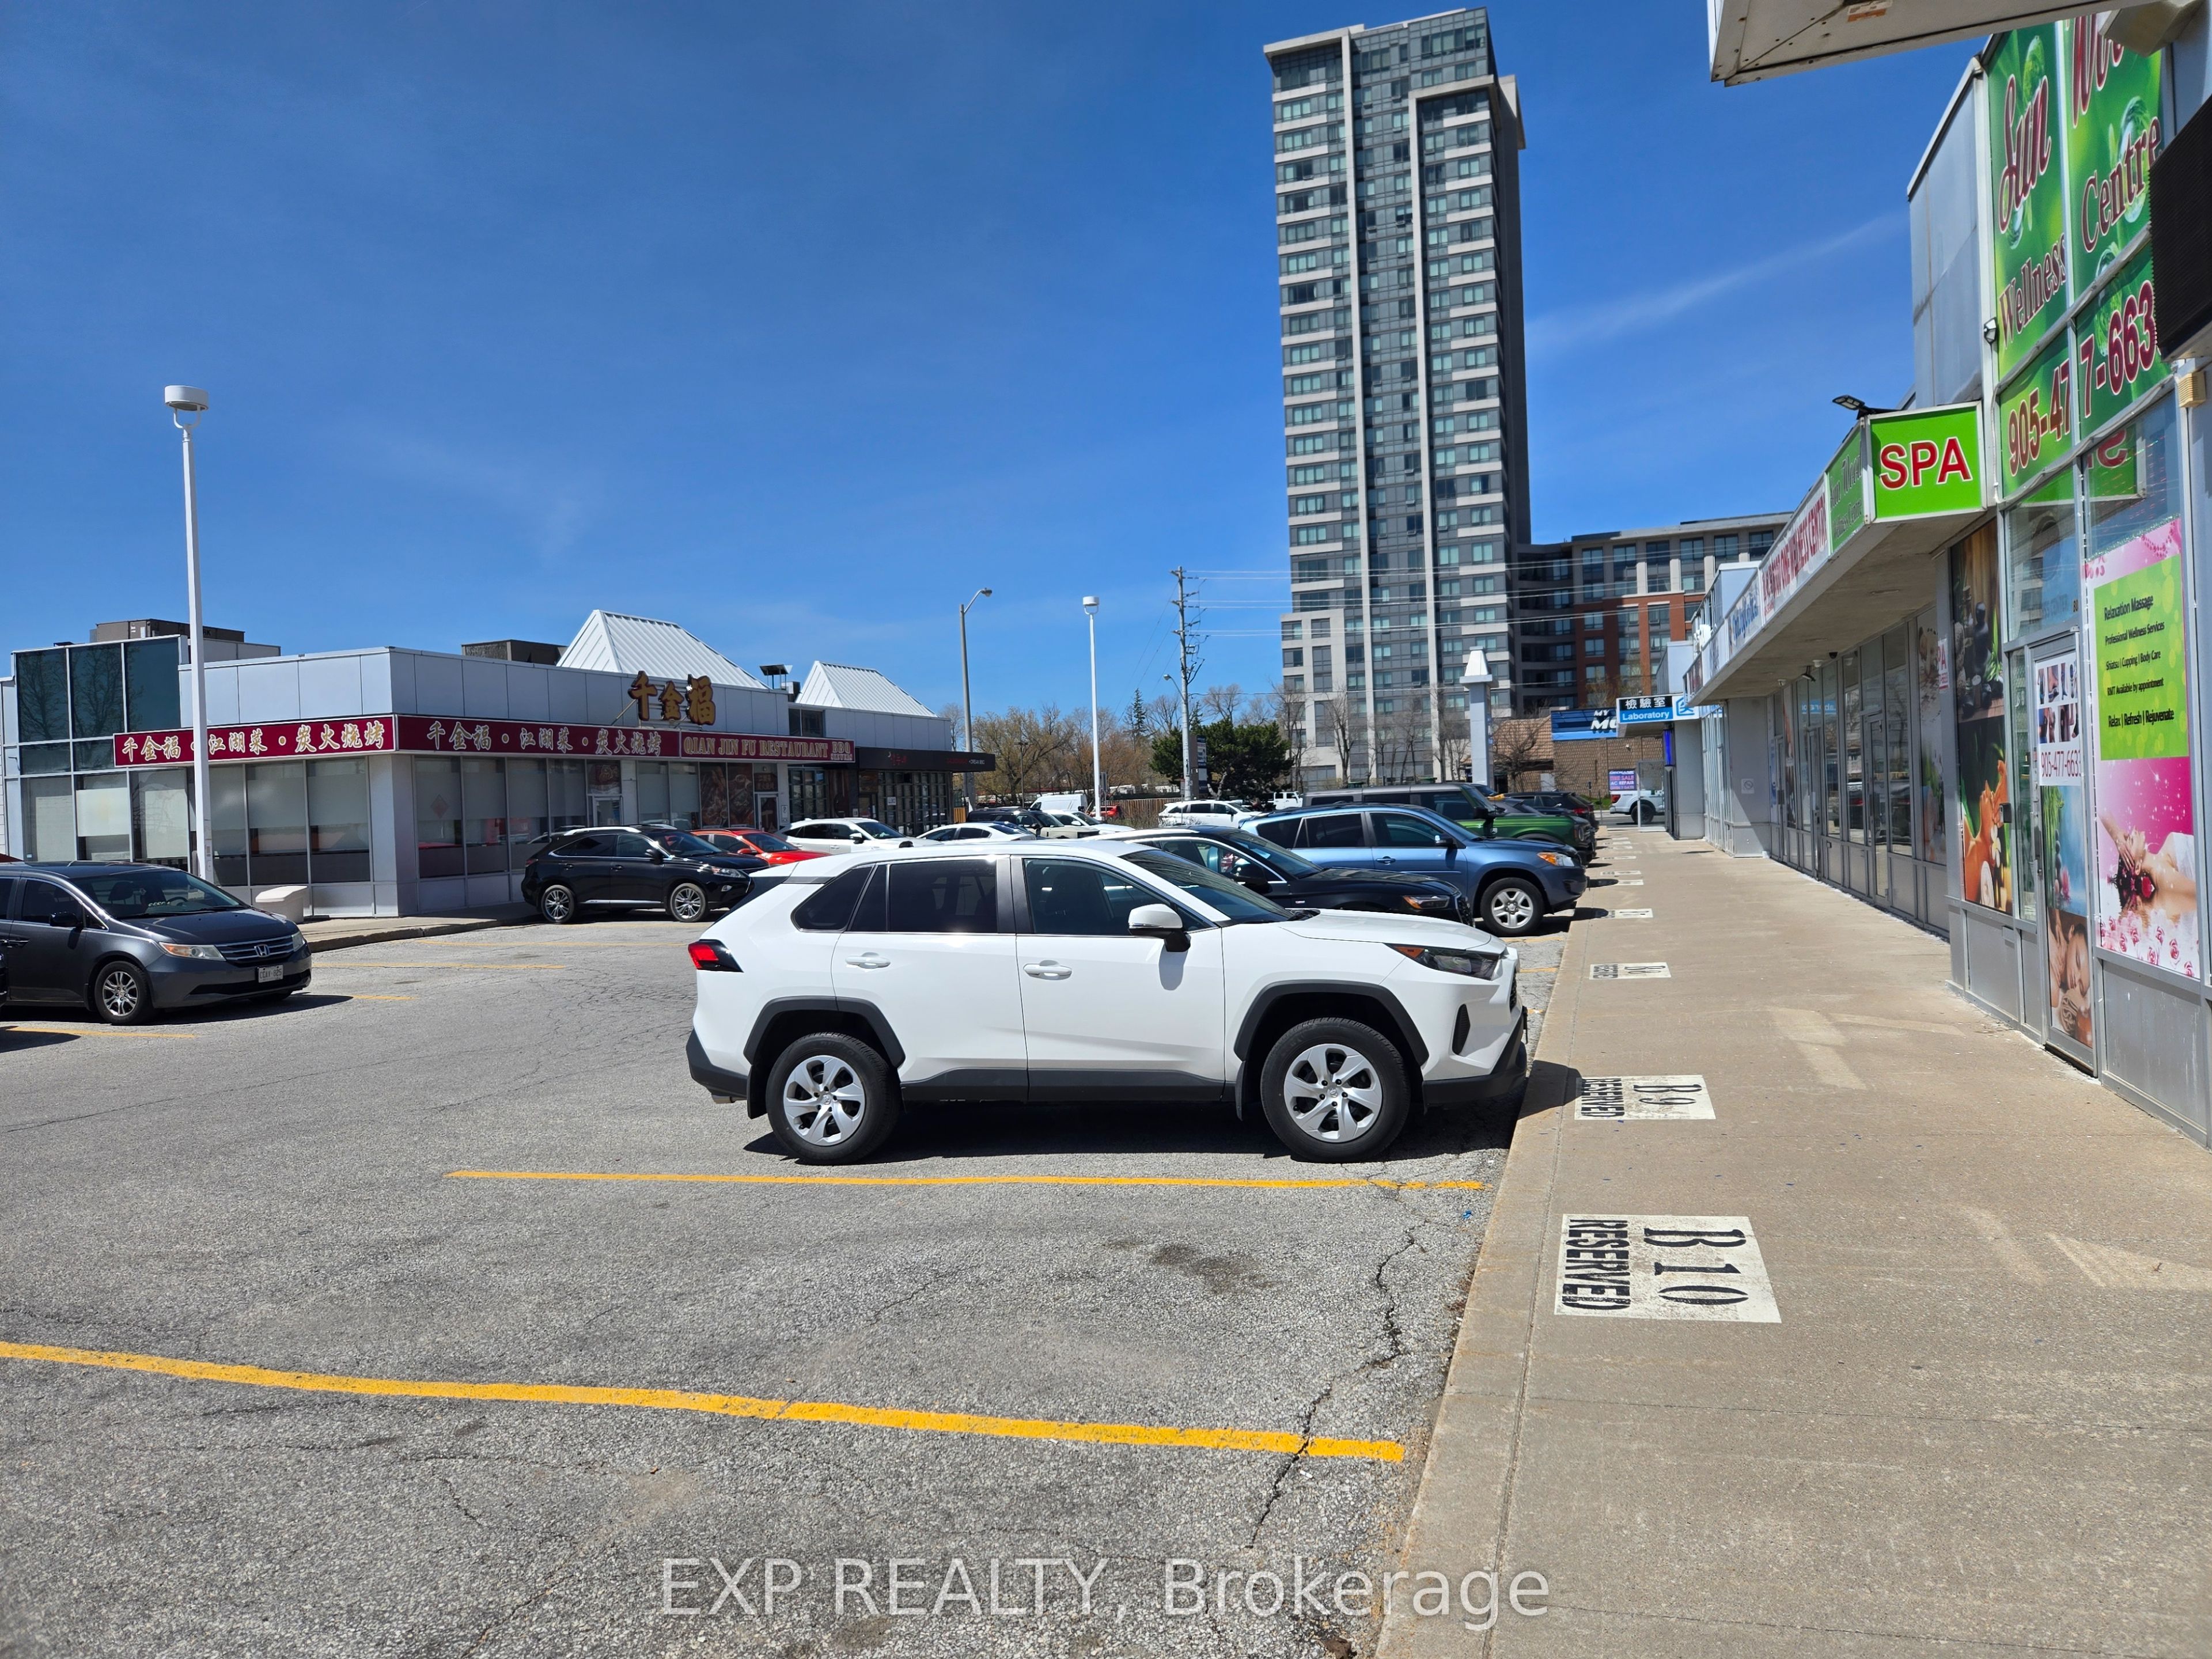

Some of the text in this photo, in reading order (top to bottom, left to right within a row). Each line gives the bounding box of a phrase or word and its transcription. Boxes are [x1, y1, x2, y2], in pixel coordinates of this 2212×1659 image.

[1998, 74, 2052, 234] Sun
[1998, 232, 2066, 349] Wellness
[2008, 280, 2157, 477] 905-477-663
[1880, 436, 1973, 490] SPA
[2104, 595, 2154, 621] Relaxation Massage
[2105, 621, 2165, 646] Professional Wellness Services
[2106, 650, 2161, 671] Shiatsu Cupping Body Care
[627, 671, 715, 726] 千金福
[2116, 683, 2132, 695] Available
[2133, 682, 2138, 693] by
[2138, 677, 2164, 692] appointment
[1622, 711, 1670, 720] Laboratory
[1625, 697, 1666, 709] 檢驗室
[2108, 709, 2175, 728] Relax Refresh Rejuvenate
[122, 720, 385, 762] 千金福 江湖菜 炭火烧烤
[427, 720, 662, 757] 千金福 江湖菜 炭火烧烤
[684, 737, 828, 757] QIAN JIN FU RESTAURANT
[832, 741, 851, 754] BBQ
[1581, 1078, 1625, 1117] RESERVED
[1634, 1084, 1702, 1105] B9
[1562, 1219, 1631, 1310] RESERVED
[1643, 1228, 1749, 1305] B10
